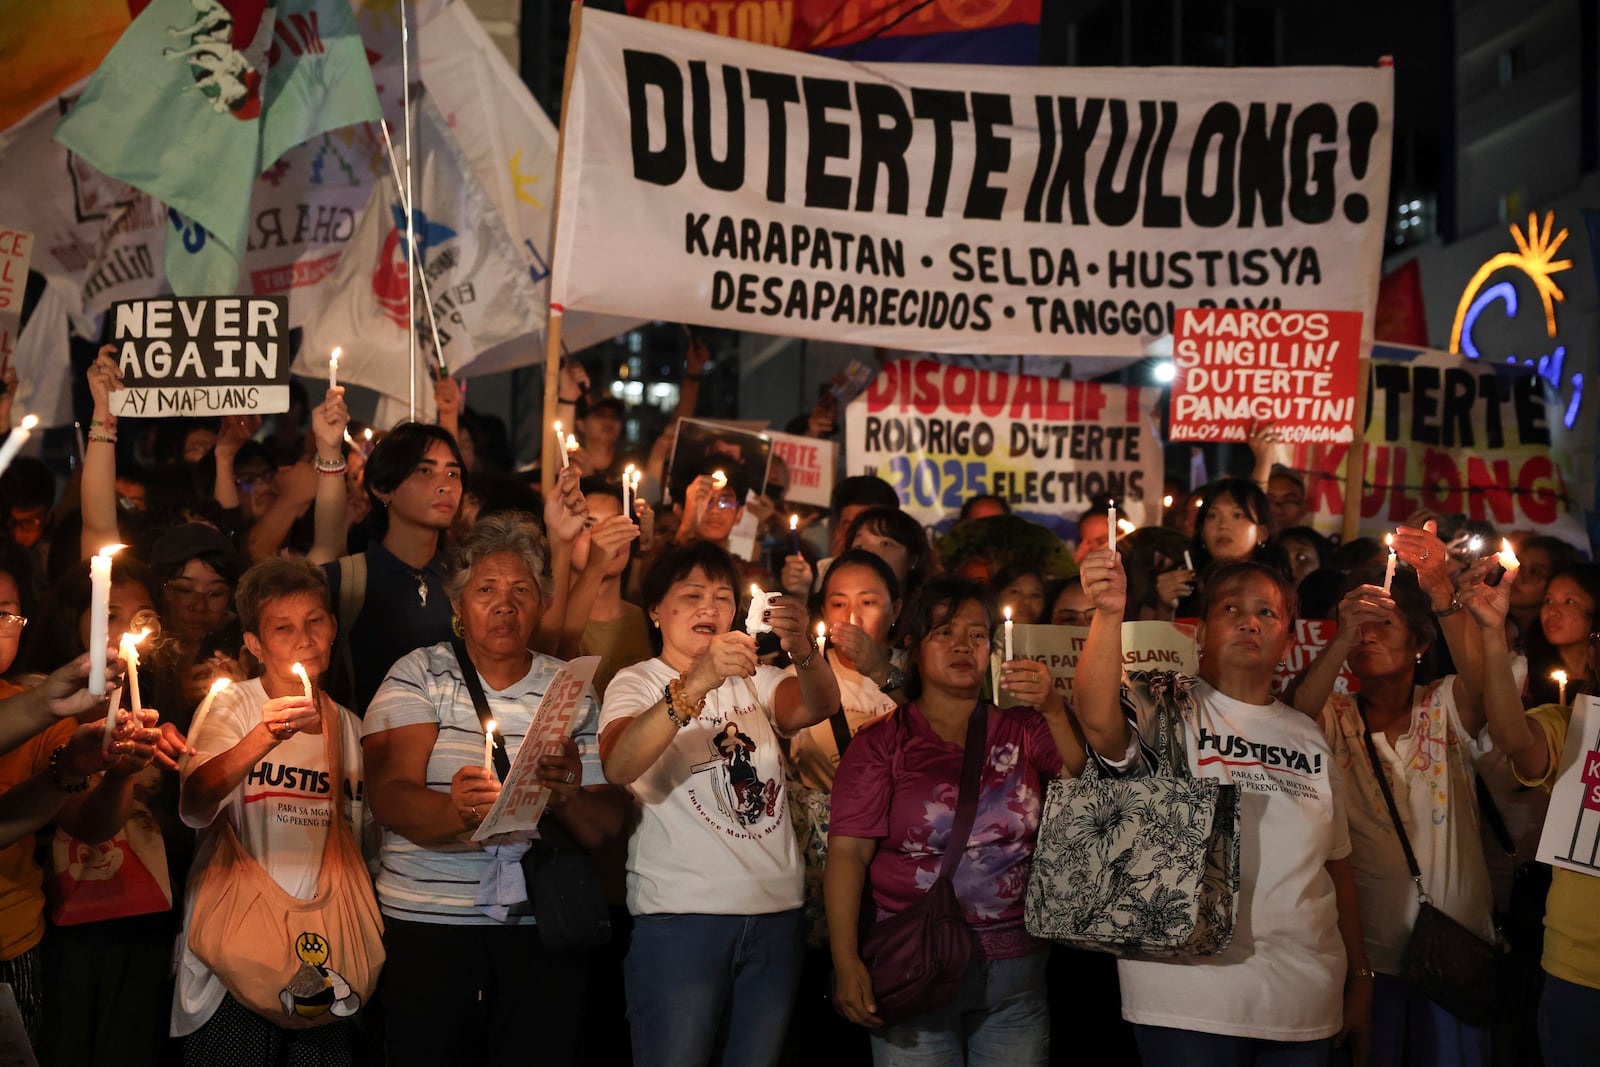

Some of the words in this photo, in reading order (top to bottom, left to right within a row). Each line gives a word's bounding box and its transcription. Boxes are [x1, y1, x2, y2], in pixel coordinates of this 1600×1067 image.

[622, 49, 1013, 221] DUTERTE
[1023, 95, 1379, 229] IKULONG!
[686, 213, 905, 277] KARAPATAN
[949, 243, 1081, 287] SELDA
[1109, 246, 1322, 288] HUSTISYA
[115, 299, 280, 340] NEVER
[711, 270, 992, 333] DESAPARECIDOS
[1183, 310, 1329, 341] MARCOS
[119, 340, 278, 379] AGAIN
[1176, 339, 1340, 371] SINGILIN!
[121, 389, 149, 415] AY
[158, 388, 260, 412] MAPUANS
[1186, 368, 1333, 397] DUTERTE
[865, 417, 994, 457] RODRIGO
[1009, 423, 1141, 462] DUTERTE
[1170, 424, 1220, 440] KILOS
[1222, 425, 1247, 440] NA
[889, 457, 987, 509] 2025
[992, 470, 1144, 504] ELECTIONS
[1197, 728, 1321, 774] HUSTISYA!
[248, 762, 363, 802] HUSTIS!
[1231, 770, 1252, 780] PARA
[1254, 773, 1265, 781] SA
[1246, 781, 1278, 792] PEKENG
[276, 815, 288, 823] NG
[290, 817, 319, 827] PEKENG
[278, 803, 297, 814] PARA
[299, 806, 308, 815] SA
[311, 808, 329, 817] MGA
[688, 789, 722, 831] Embrace
